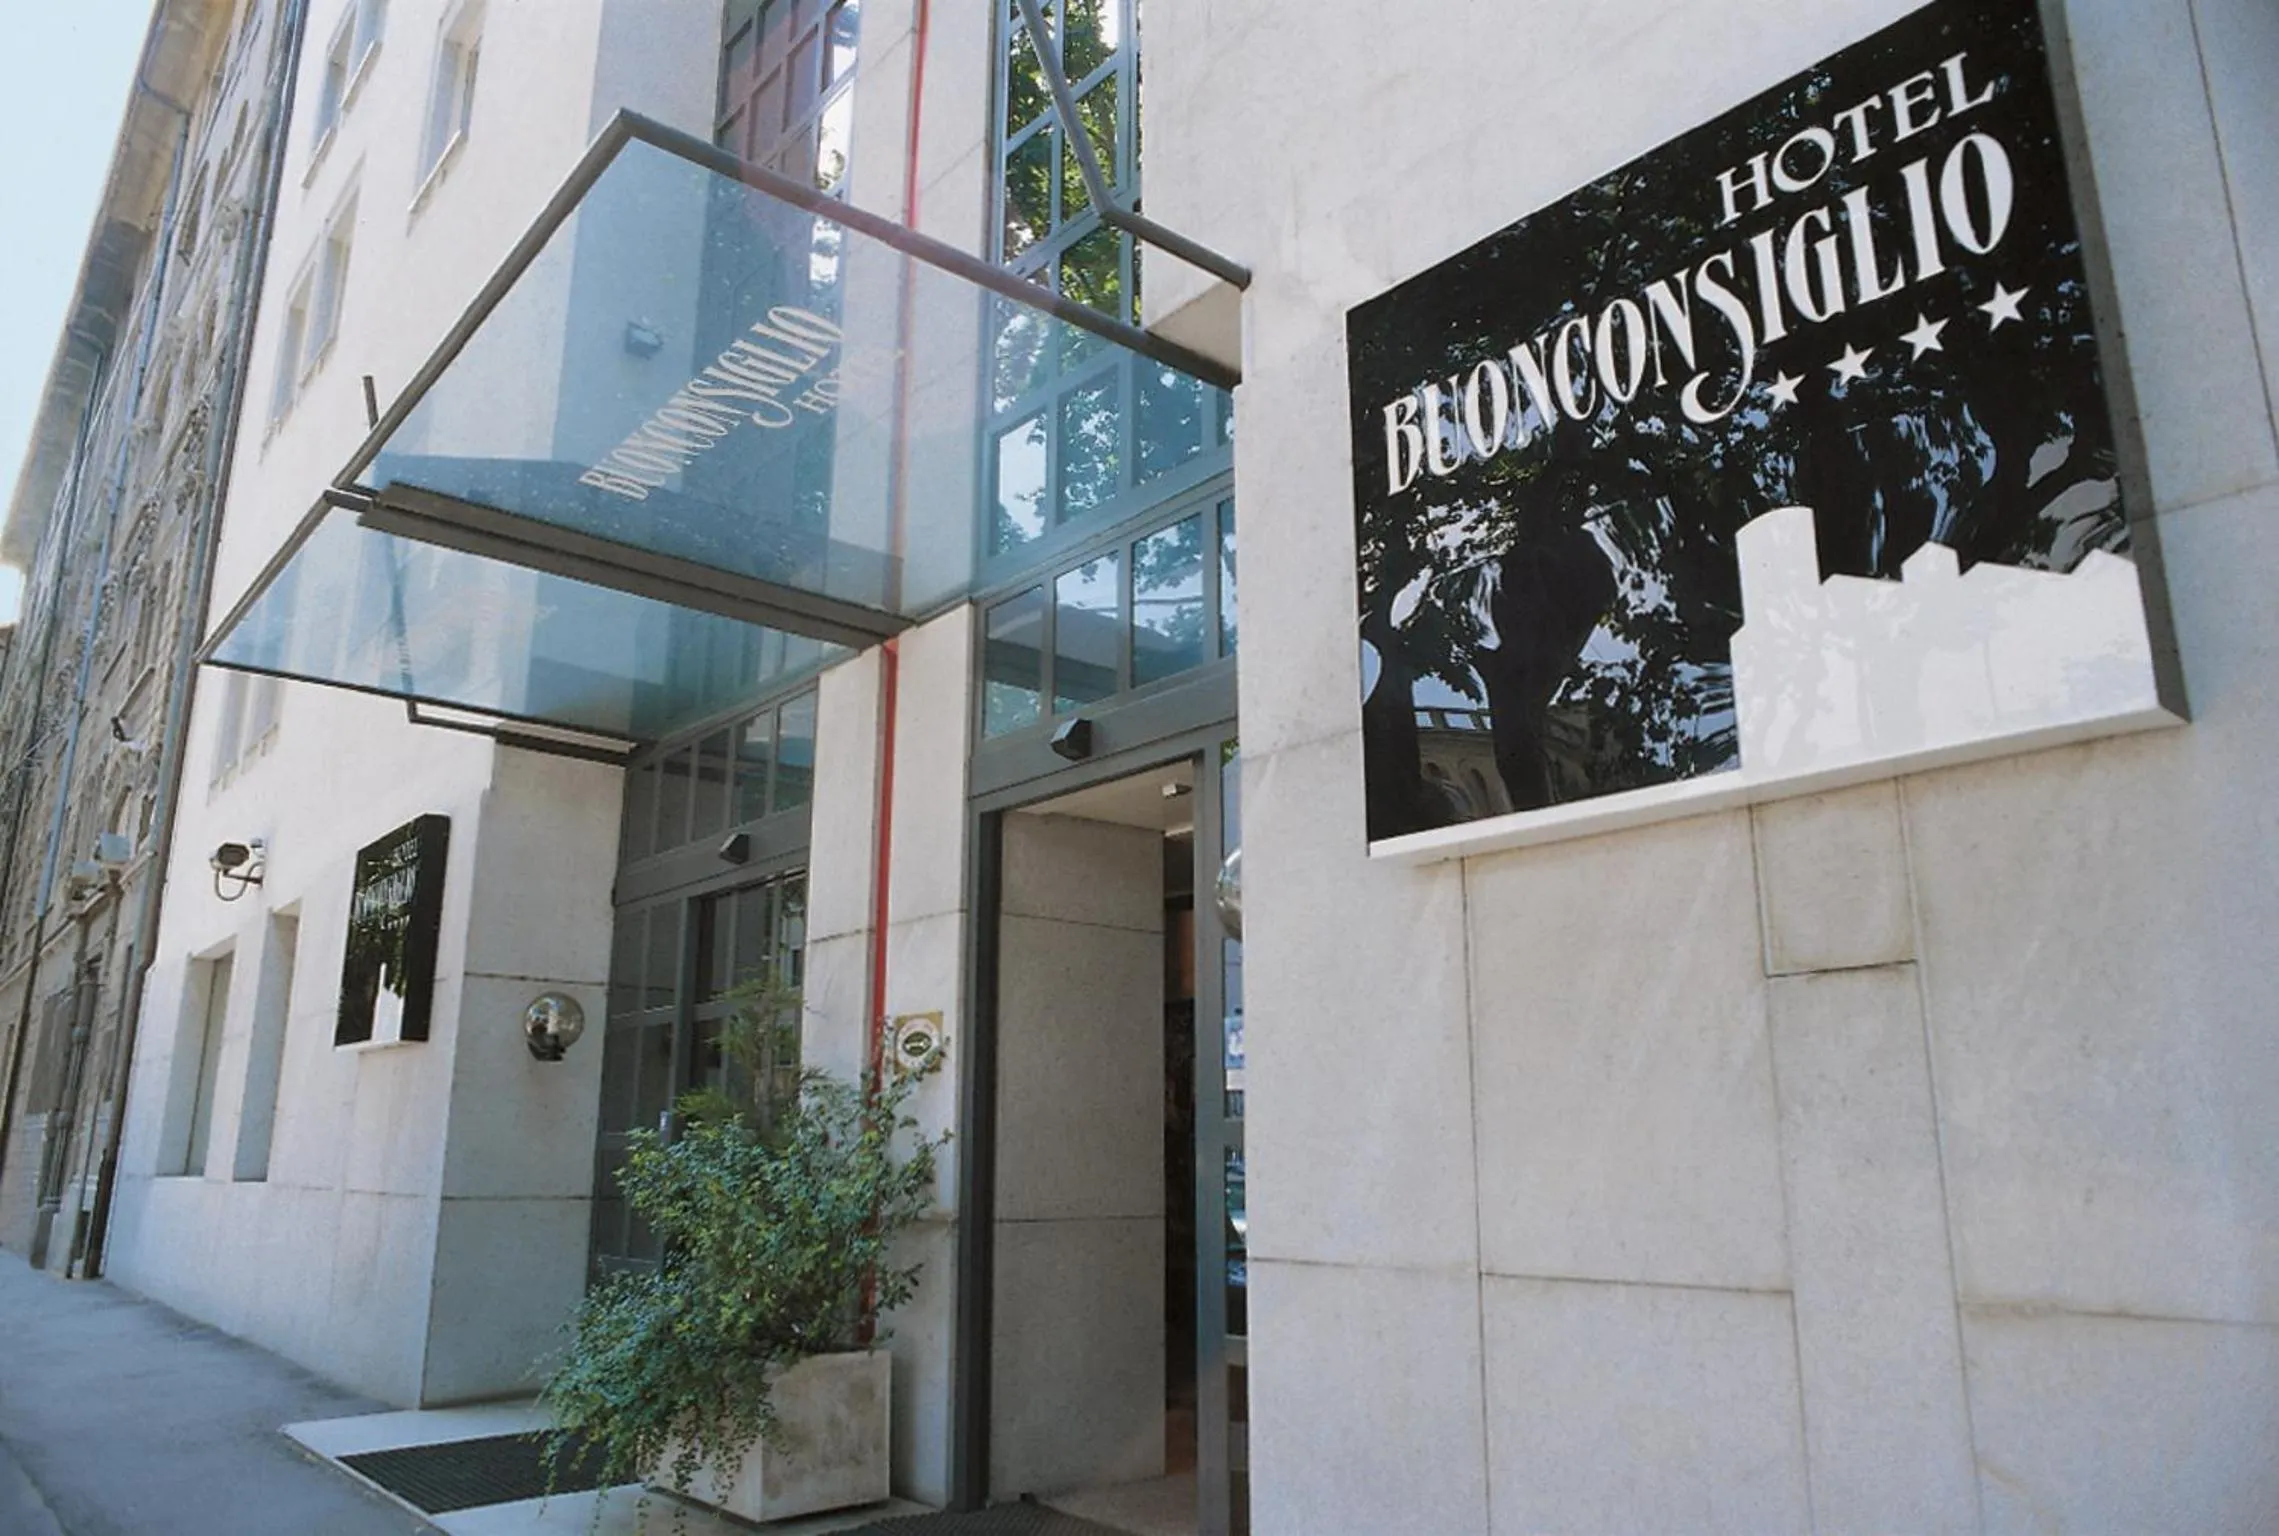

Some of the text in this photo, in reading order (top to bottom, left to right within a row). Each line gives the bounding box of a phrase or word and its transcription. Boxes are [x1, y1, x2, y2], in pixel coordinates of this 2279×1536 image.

[1715, 52, 1996, 226] HOTEL
[577, 306, 844, 500] BUONCONSIGLIO
[1382, 132, 2014, 496] BUONCONSIGLIO
